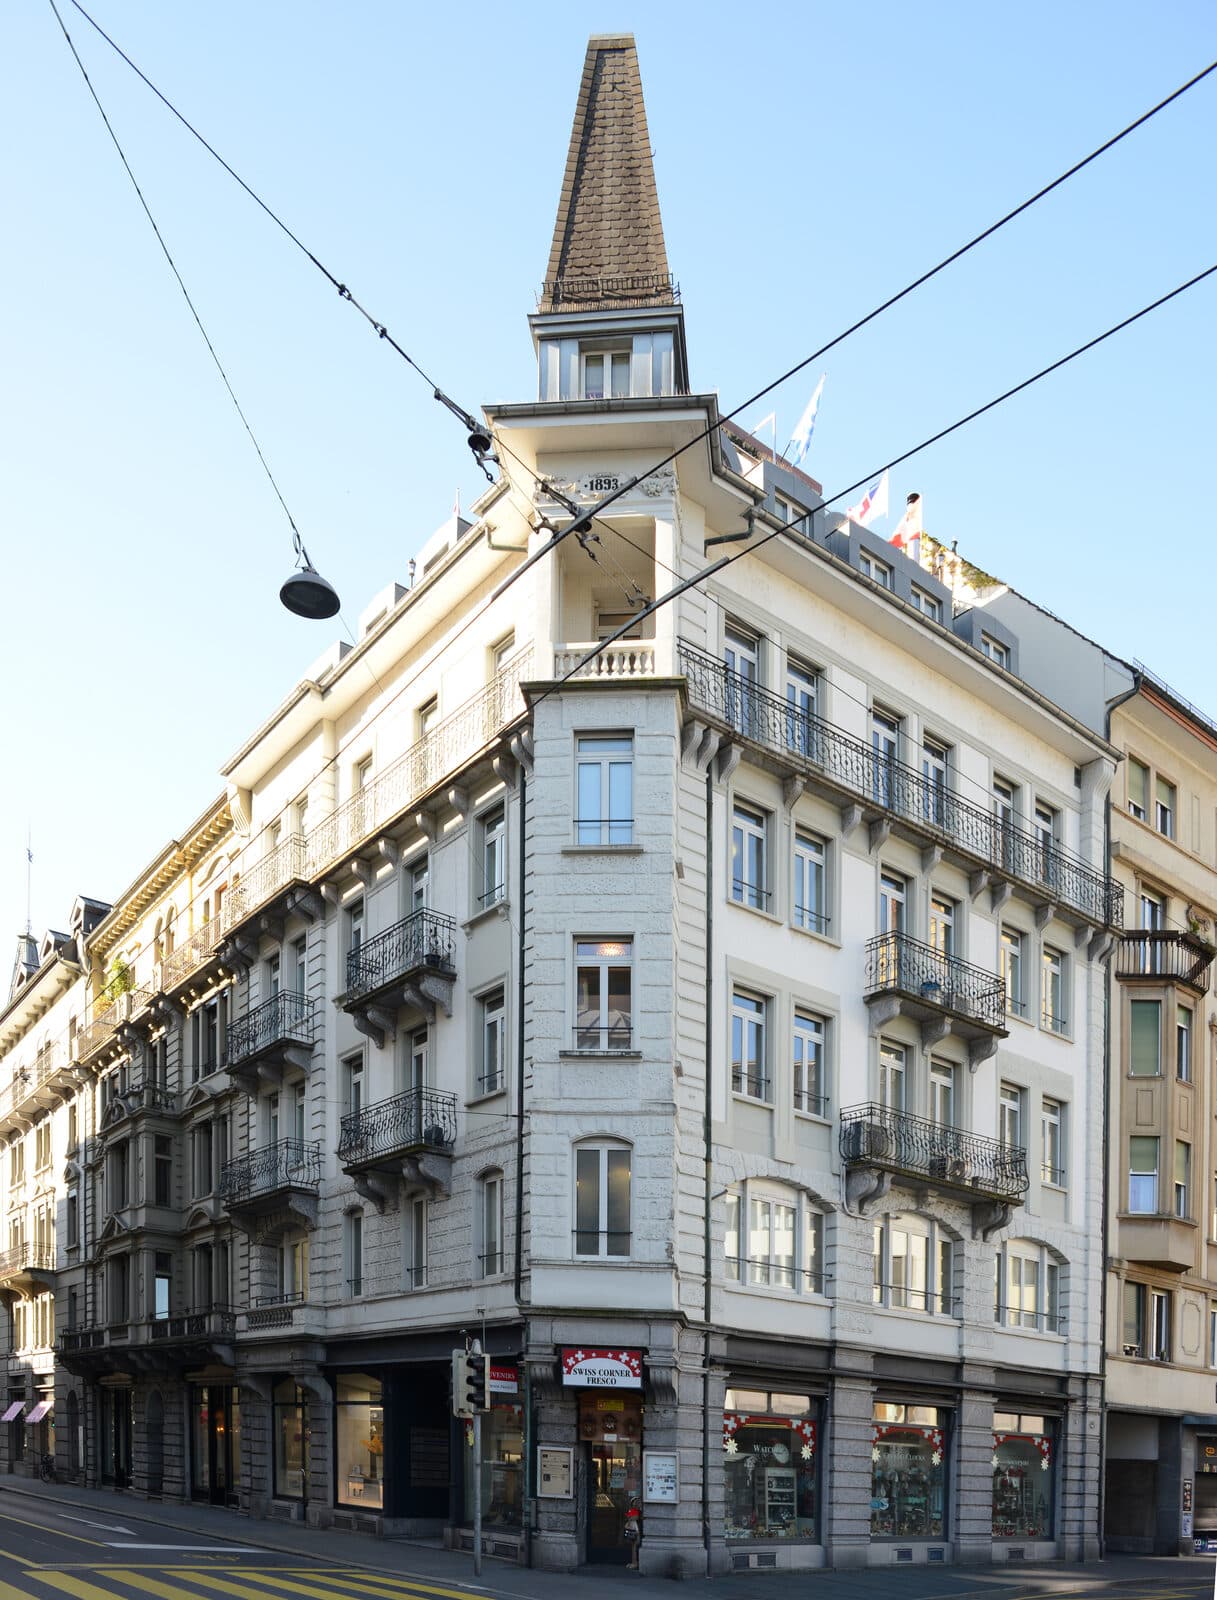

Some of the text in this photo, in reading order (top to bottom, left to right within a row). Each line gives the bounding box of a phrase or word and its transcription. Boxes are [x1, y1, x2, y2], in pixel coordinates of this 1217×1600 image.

[589, 478, 619, 491] 1893
[490, 1371, 515, 1380] VENIRS
[572, 1368, 631, 1378] SWISS CORNER
[586, 1376, 617, 1385] FRESCO
